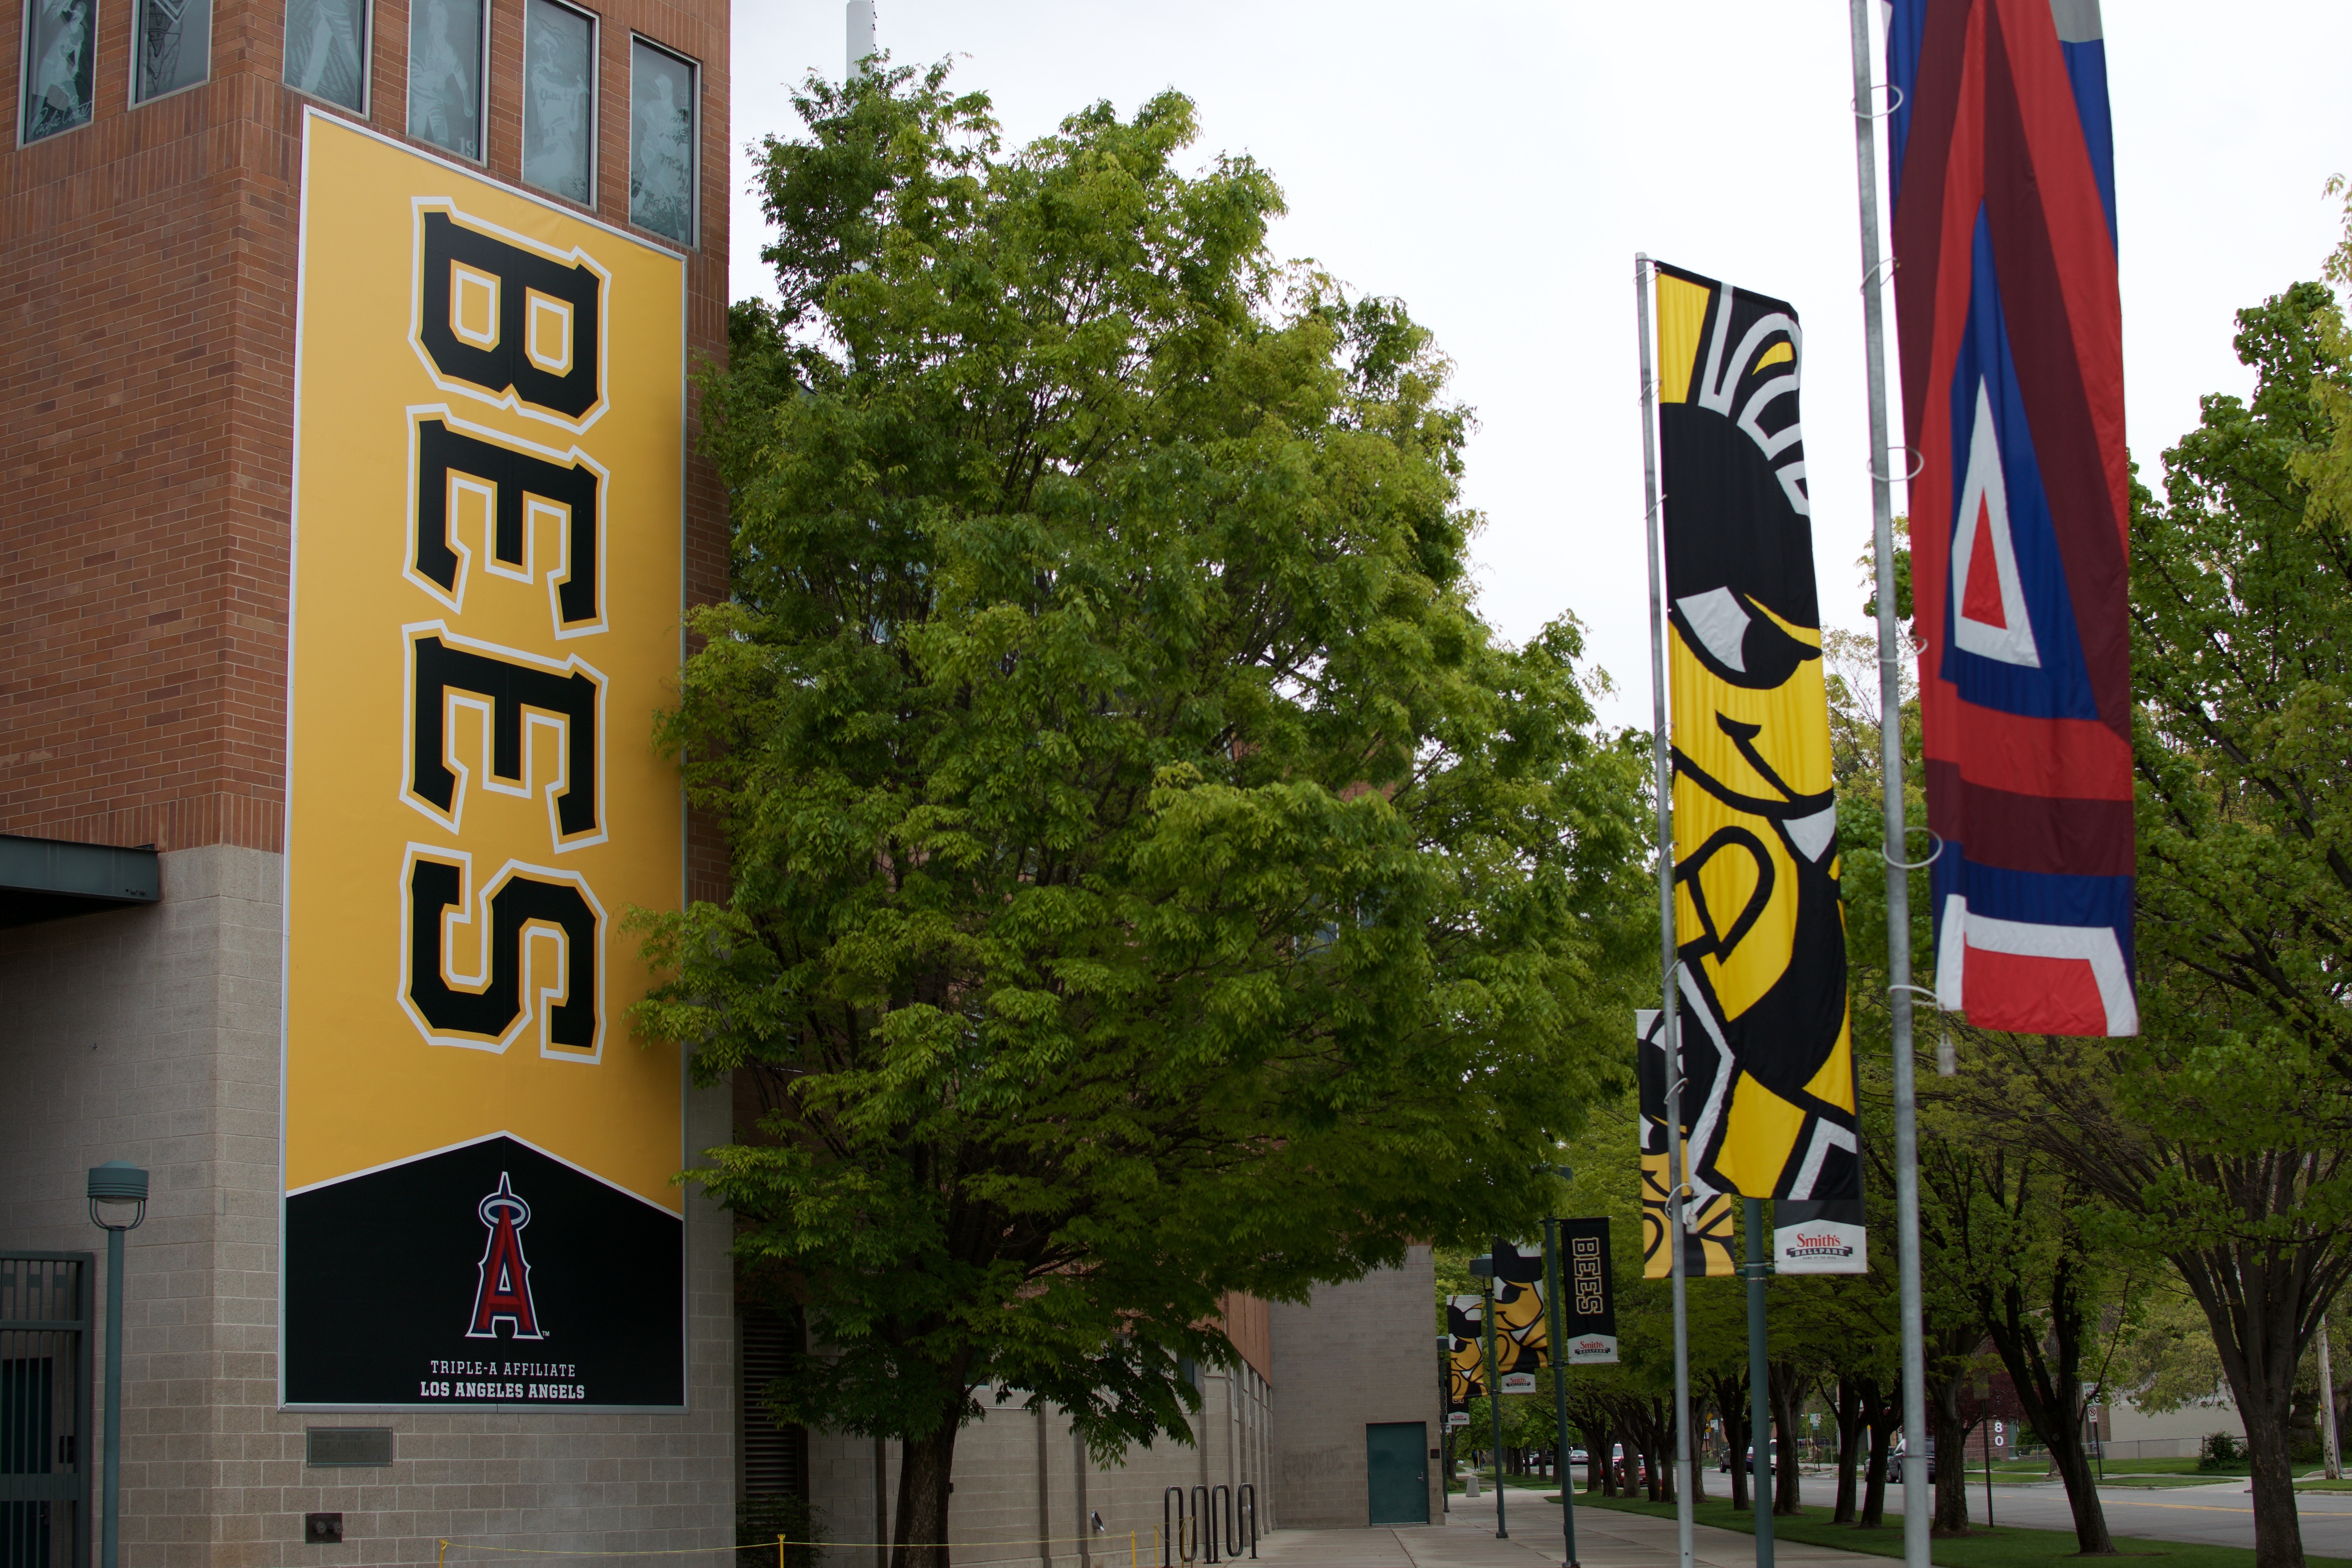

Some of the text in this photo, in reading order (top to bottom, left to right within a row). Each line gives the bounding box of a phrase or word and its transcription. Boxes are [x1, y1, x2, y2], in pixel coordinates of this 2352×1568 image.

[459, 137, 477, 159] 19
[398, 196, 611, 1064] BEES
[1797, 1233, 1840, 1247] Smith's
[1795, 1248, 1844, 1256] BALLPARK
[1572, 1237, 1603, 1315] BEES
[1580, 1341, 1604, 1349] Smith's
[431, 1360, 575, 1377] TRIPLE-A AFFILIATE
[421, 1381, 585, 1399] LOS ANGELES ANGELS
